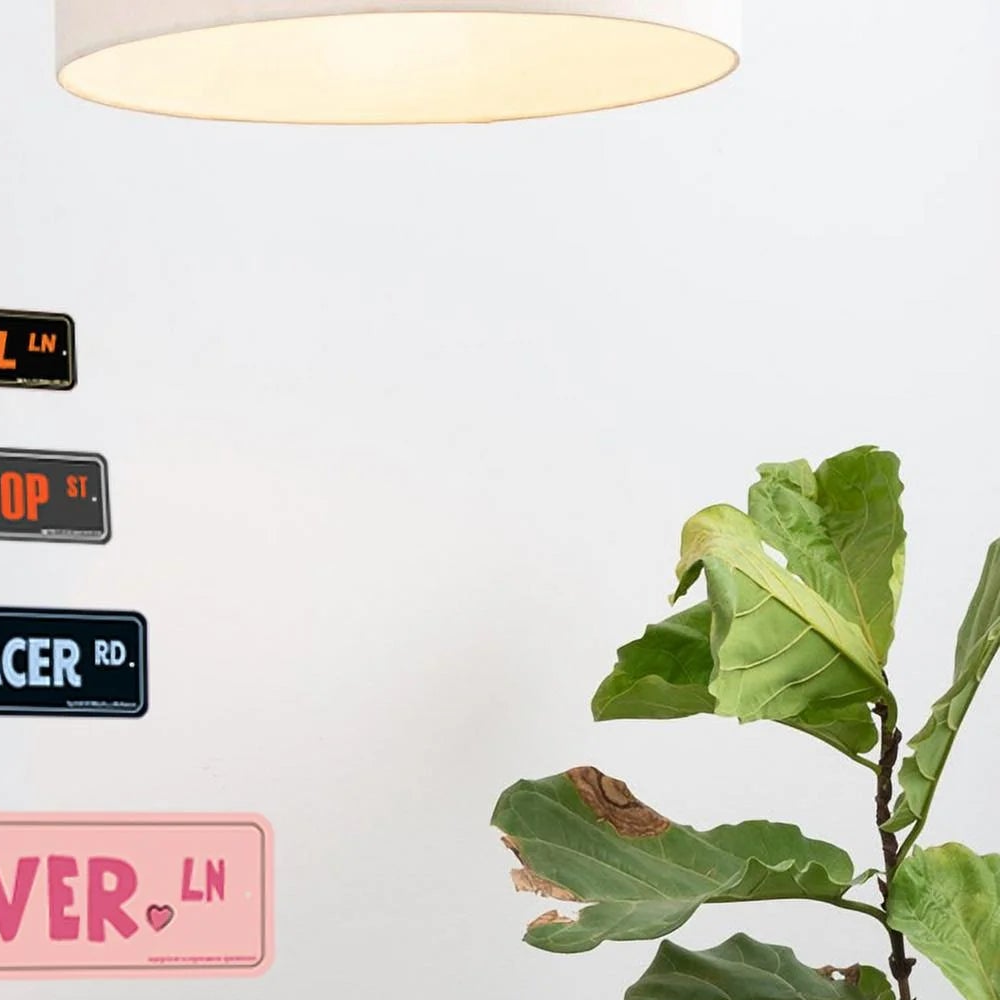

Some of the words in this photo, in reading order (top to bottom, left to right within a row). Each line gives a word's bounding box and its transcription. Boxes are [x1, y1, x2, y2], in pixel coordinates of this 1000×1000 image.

[27, 332, 57, 353] LN
[66, 474, 89, 499] ST
[94, 639, 126, 667] RD
[181, 858, 226, 902] LN
